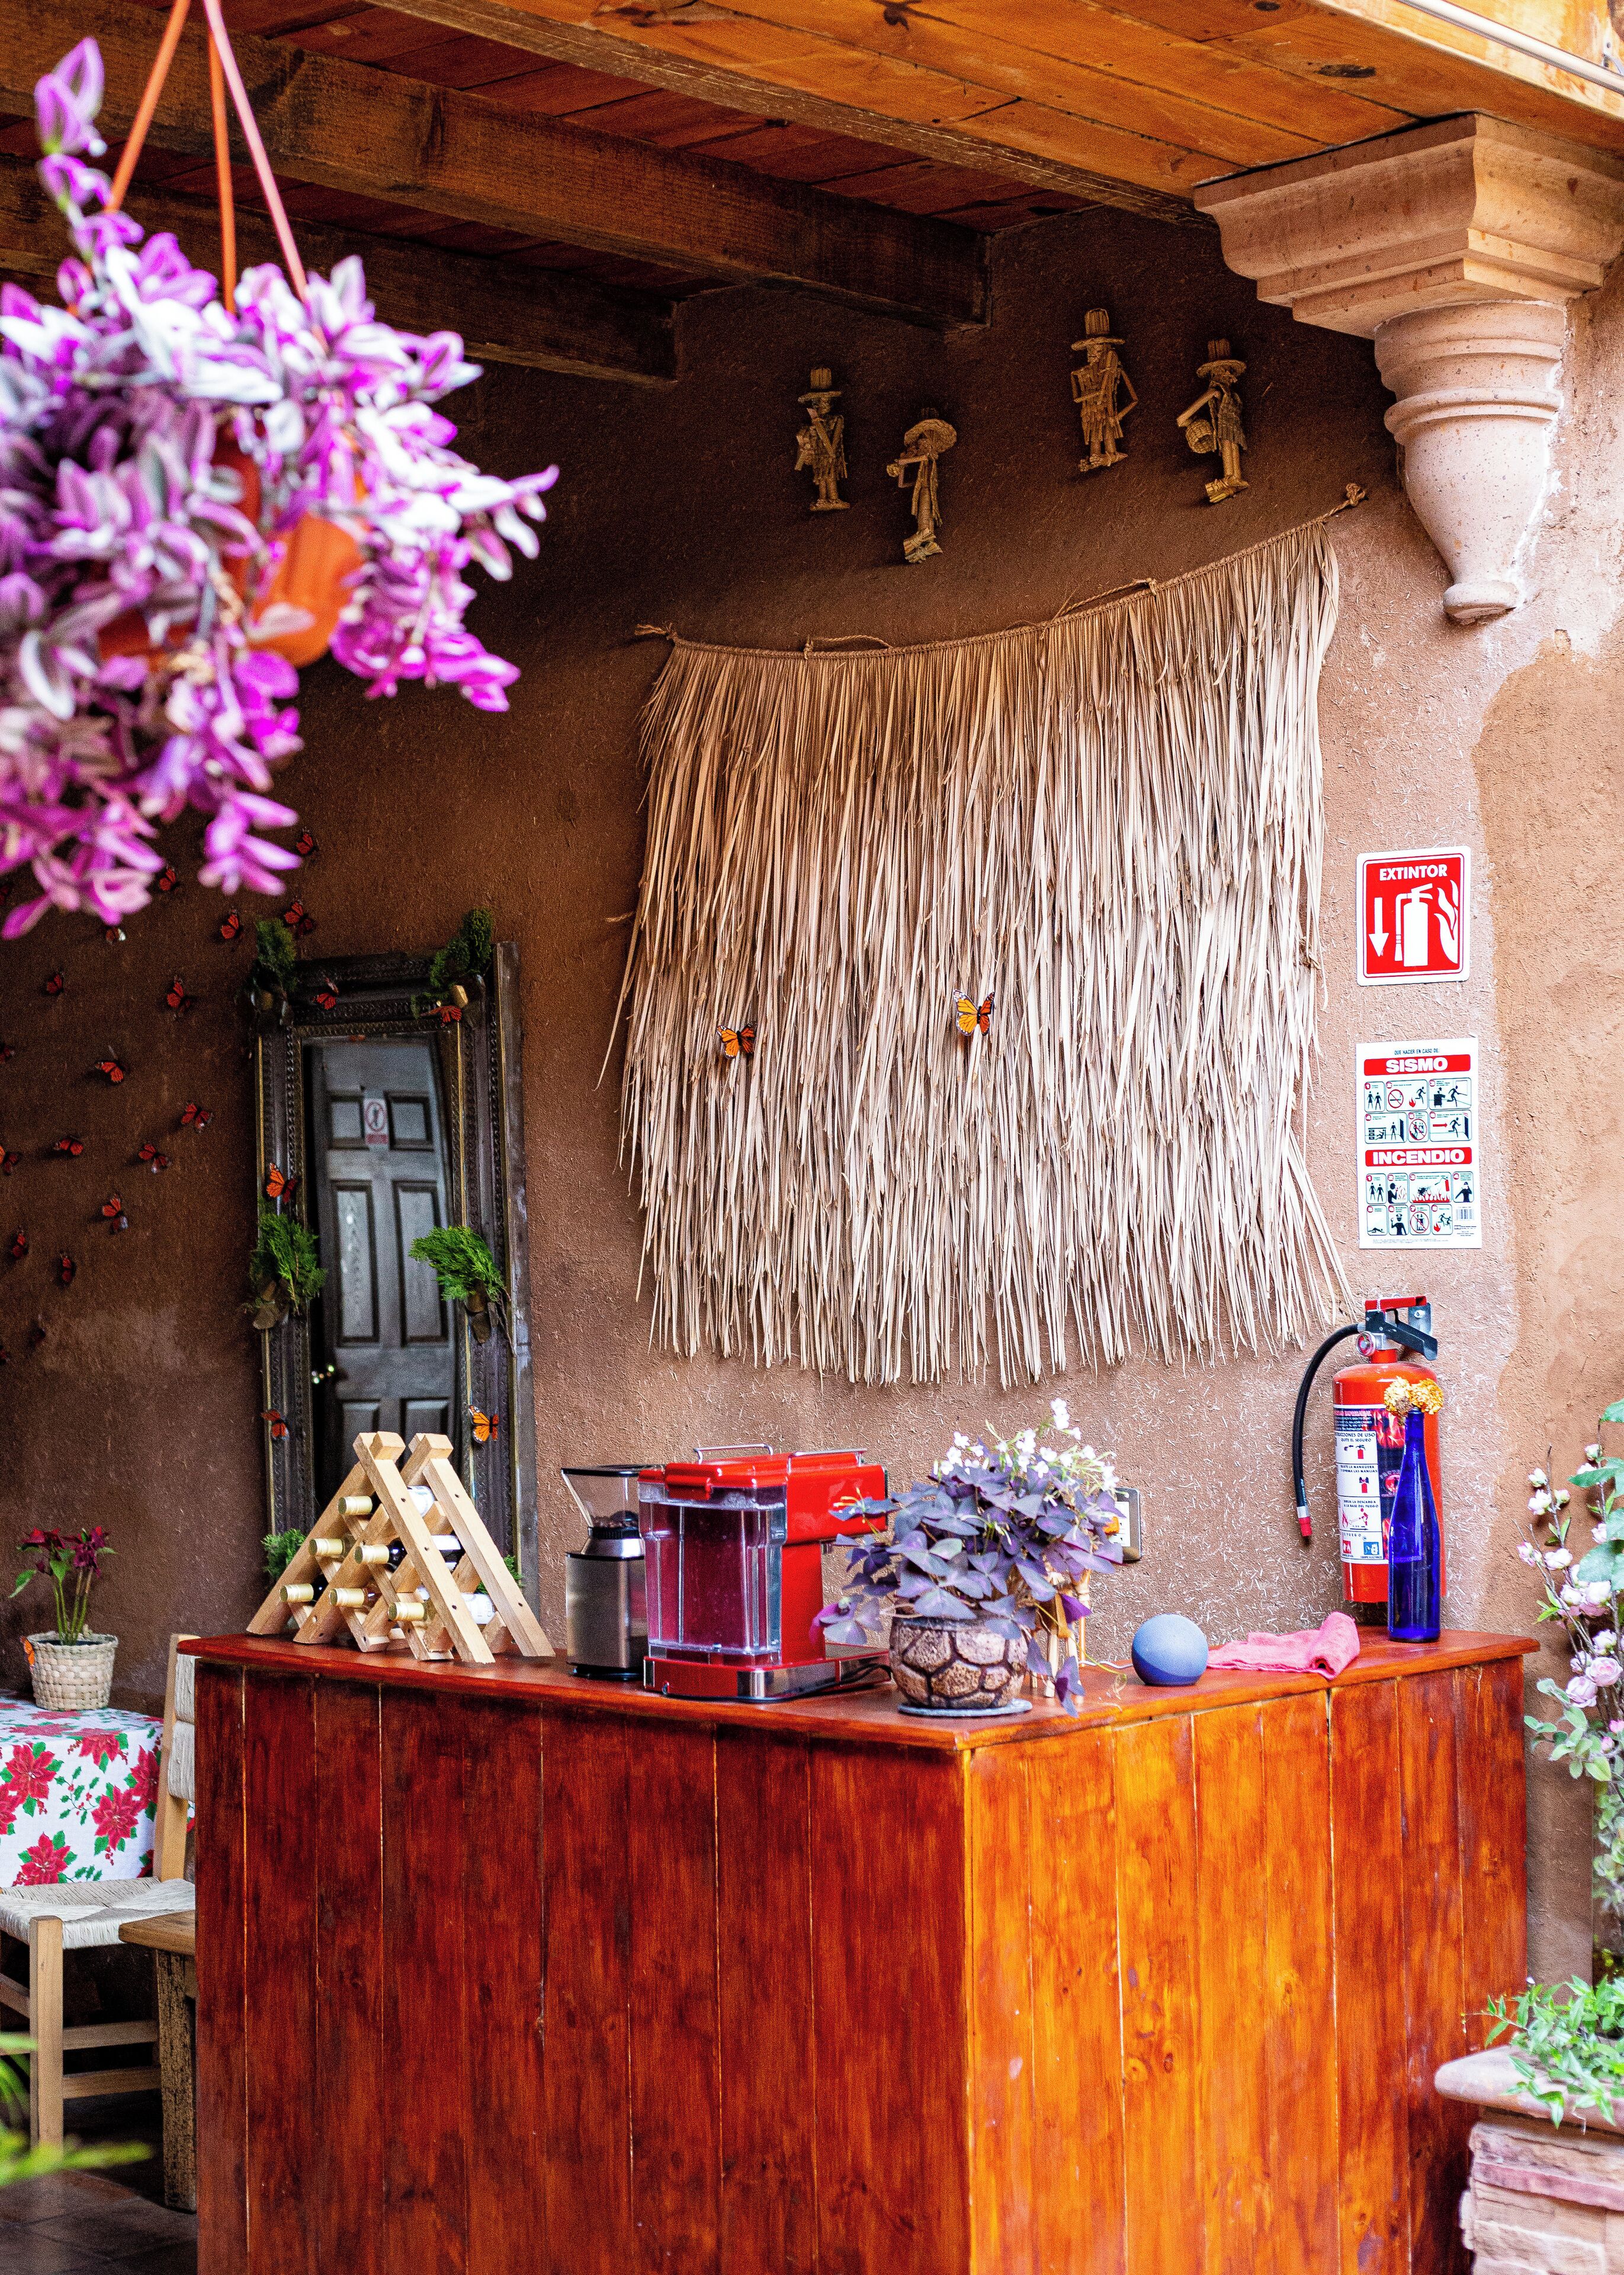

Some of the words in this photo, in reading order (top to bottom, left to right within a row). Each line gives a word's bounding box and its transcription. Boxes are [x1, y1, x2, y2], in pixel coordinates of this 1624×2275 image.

[1379, 864, 1448, 881] EXTINTOR
[1386, 1057, 1448, 1073] SISMO
[1372, 1149, 1465, 1165] INCENDIO
